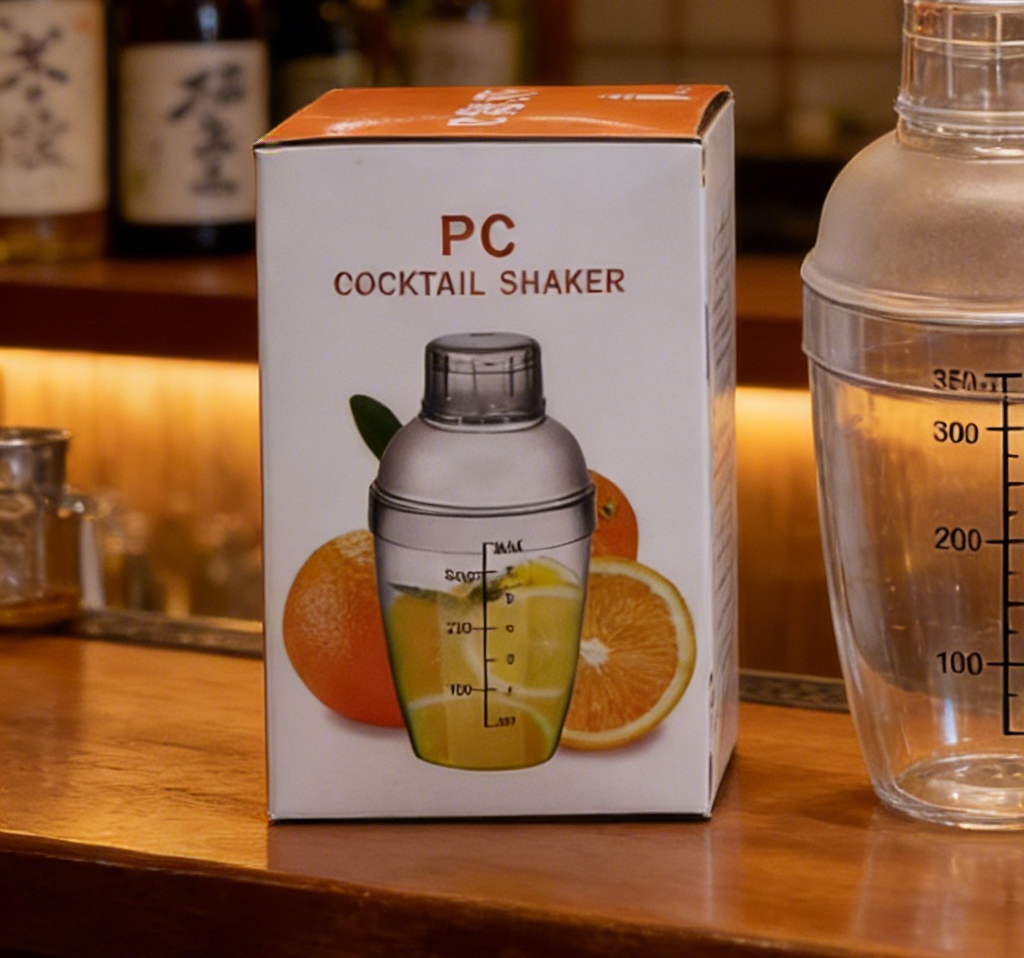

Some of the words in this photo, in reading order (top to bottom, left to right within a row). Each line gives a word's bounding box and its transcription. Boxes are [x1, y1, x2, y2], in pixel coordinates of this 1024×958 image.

[441, 214, 516, 258] PC
[334, 271, 486, 297] COCKTAIL
[499, 268, 625, 295] SHAKER
[933, 421, 979, 444] 300
[934, 526, 982, 552] 200
[936, 651, 983, 675] 100
